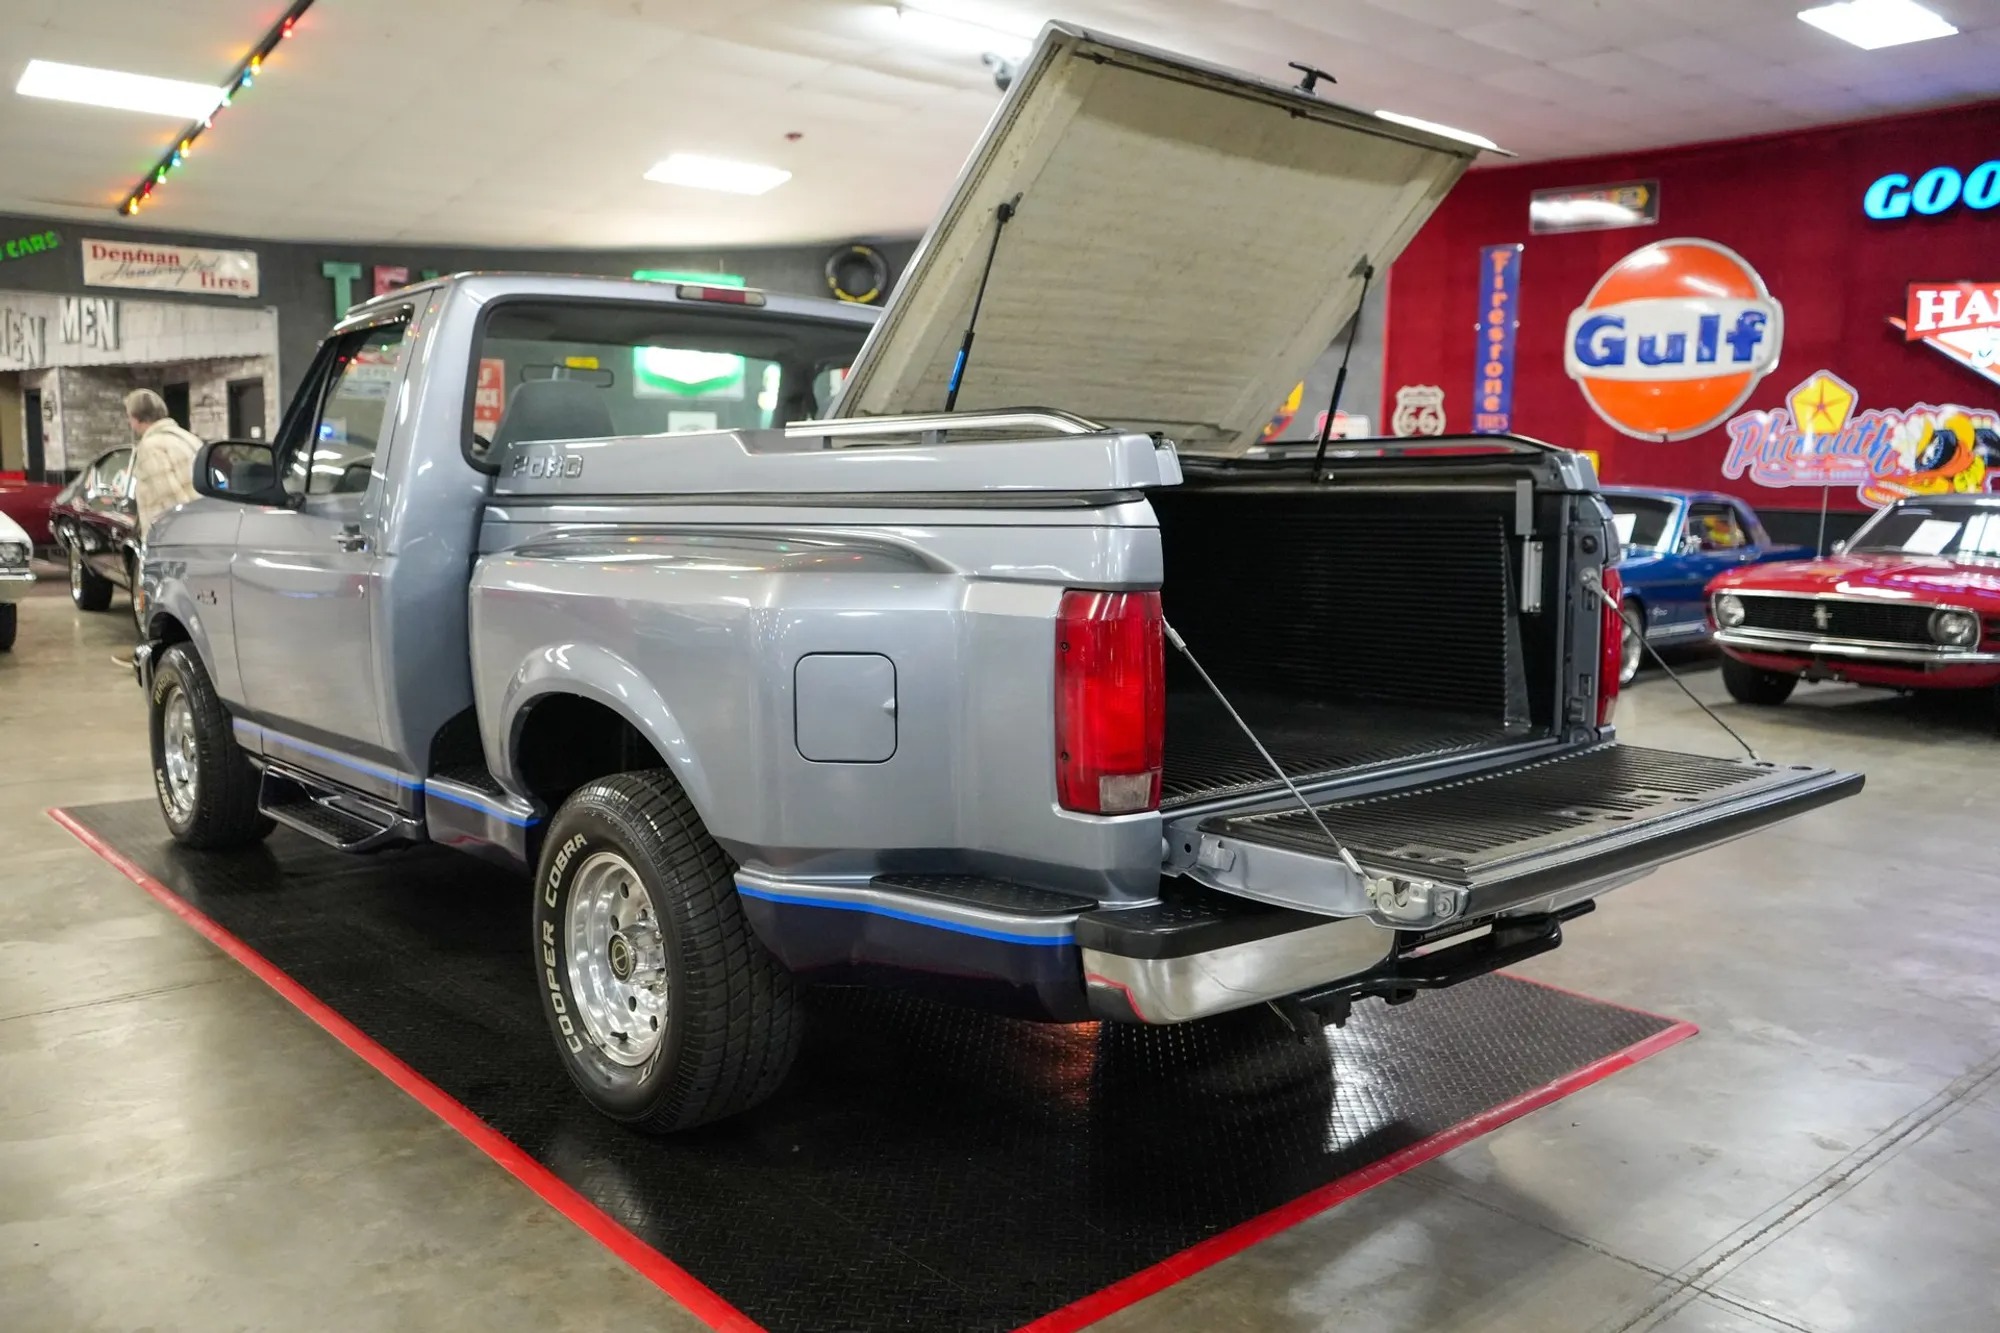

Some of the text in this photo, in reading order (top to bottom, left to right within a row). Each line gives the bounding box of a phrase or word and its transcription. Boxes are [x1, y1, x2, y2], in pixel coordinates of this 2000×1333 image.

[1863, 160, 2000, 221] GOO
[6, 230, 59, 257] CARS
[92, 245, 180, 266] Denman
[200, 271, 250, 290] Tires
[59, 297, 119, 350] MEN
[1483, 250, 1513, 412] Firestone
[1914, 289, 2000, 332] HA
[1574, 310, 1767, 367] Gulf
[1399, 407, 1438, 436] 66
[1731, 415, 1896, 475] Plymouth
[512, 454, 584, 479] FORD
[542, 832, 588, 1054] COOPER COBRA
